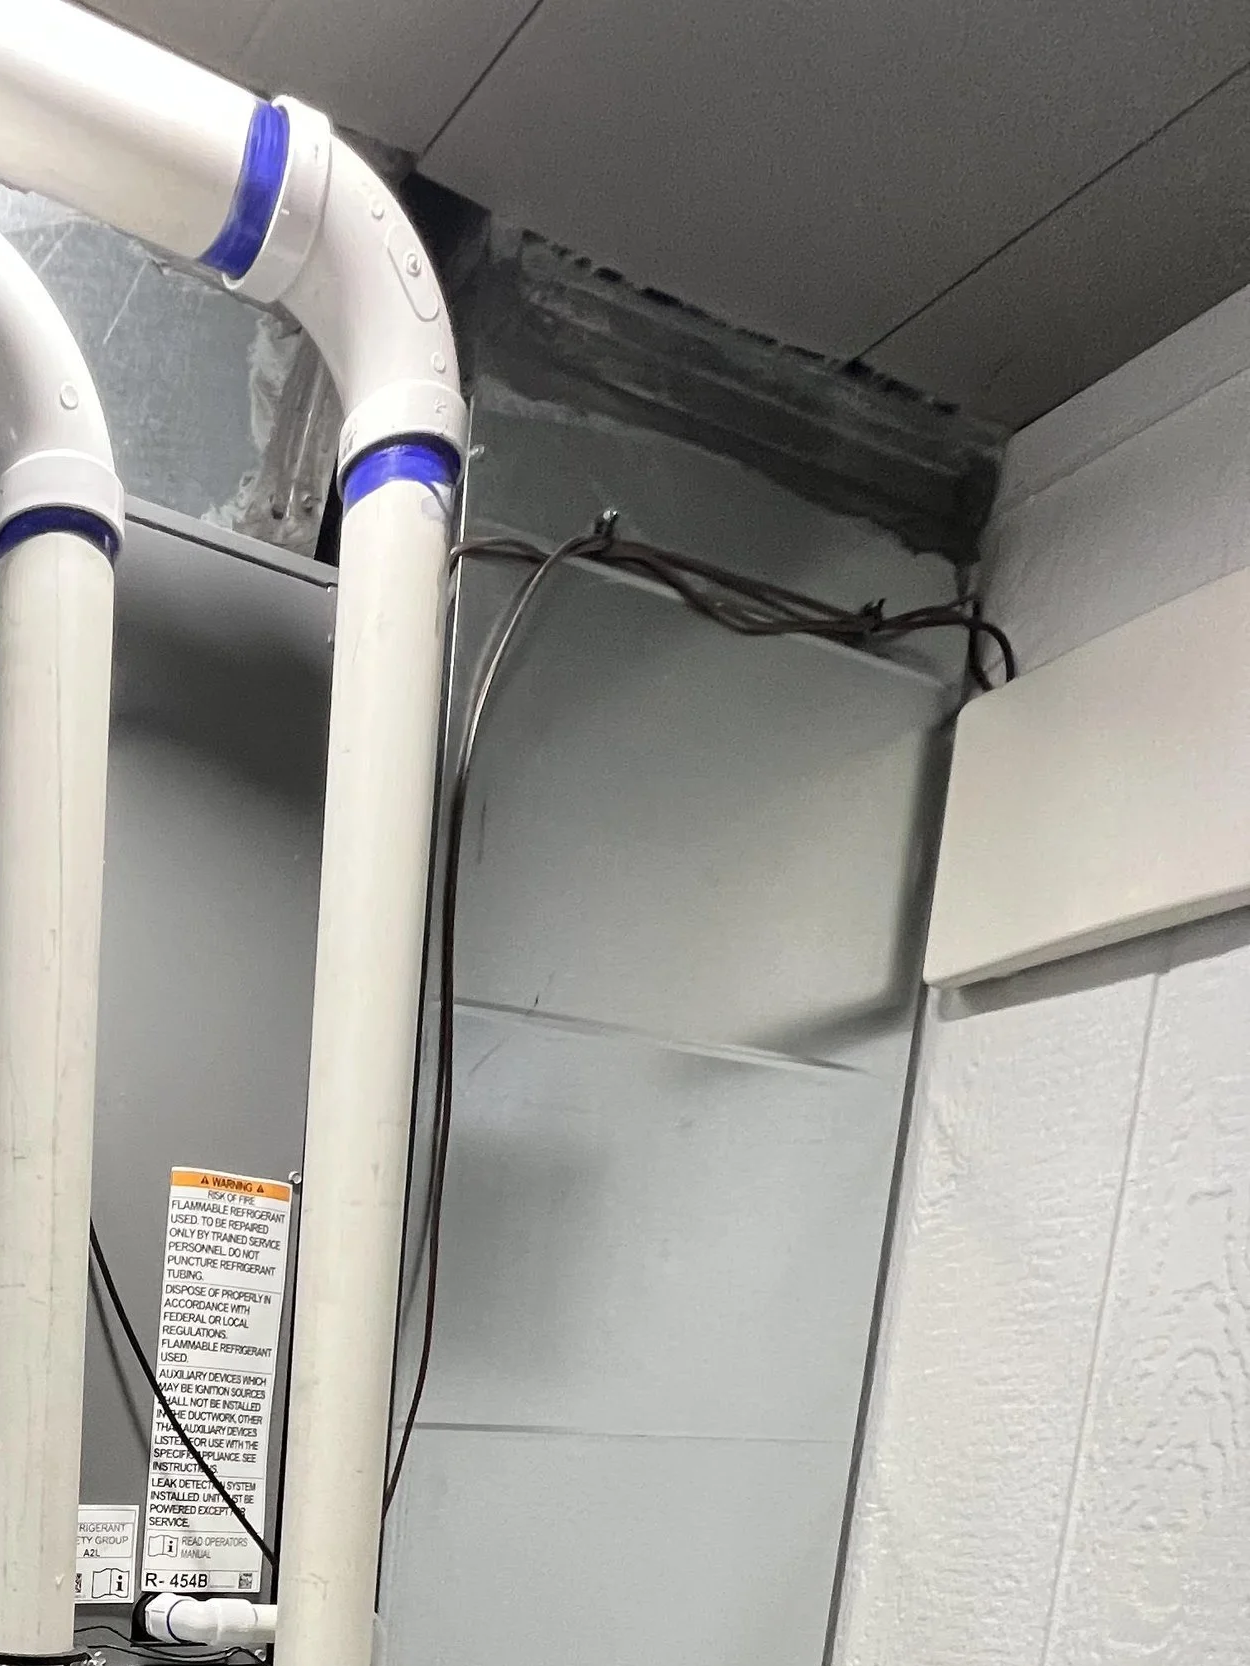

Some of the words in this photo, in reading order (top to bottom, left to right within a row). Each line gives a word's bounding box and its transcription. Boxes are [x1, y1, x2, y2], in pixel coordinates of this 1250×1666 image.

[212, 1177, 253, 1193] WARNING
[208, 1190, 225, 1201] RISK
[227, 1192, 237, 1202] OF
[239, 1194, 255, 1206] FIRE
[171, 1200, 229, 1216] FLAMMABLE
[230, 1207, 286, 1224] REFRIGERANT
[170, 1214, 199, 1225] USED.
[202, 1216, 214, 1227] TO
[215, 1218, 227, 1229] BE
[228, 1219, 270, 1235] REPAIRED
[169, 1227, 196, 1239] ONLY
[197, 1229, 210, 1240] BY
[211, 1231, 248, 1245] TRAINED
[248, 1237, 281, 1251] SERVICE
[228, 1247, 241, 1258] DO
[242, 1249, 260, 1261] NOT
[167, 1255, 219, 1269] PUNCTURE
[220, 1260, 277, 1277] REFRIGERANT
[166, 1268, 204, 1281] TUBING.
[165, 1284, 207, 1297] DISPOSE
[208, 1287, 220, 1298] OF
[221, 1289, 263, 1304] PROPERLY
[263, 1294, 272, 1305] IN
[163, 1298, 229, 1312] ACCORDANCE
[230, 1303, 251, 1315] WITH
[163, 1311, 206, 1324] FEDERAL
[208, 1315, 222, 1325] OR
[222, 1317, 250, 1329] LOCAL
[162, 1325, 228, 1339] REGULATIONS.
[161, 1338, 219, 1352] FLAMMABLE
[220, 1343, 273, 1358] REFRIGERANT
[160, 1352, 189, 1363] USED.
[158, 1368, 208, 1381] AUXILIARY
[209, 1372, 242, 1385] DEVICES
[242, 1375, 267, 1386] WHICH
[158, 1382, 180, 1392] MAY
[180, 1383, 193, 1394] BE
[194, 1384, 230, 1396] IGNITION
[231, 1388, 266, 1400] SOURCES
[158, 1395, 189, 1407] HALL
[190, 1397, 209, 1408] NOT
[210, 1398, 222, 1409] BE
[222, 1399, 261, 1412] INSTALLED
[156, 1408, 166, 1419] IN
[237, 1414, 263, 1425] OTHER
[156, 1421, 181, 1432] THA
[182, 1423, 227, 1435] AUXILIARY
[226, 1426, 258, 1438] DEVICES
[188, 1437, 207, 1448] FOR
[208, 1438, 224, 1449] USE
[225, 1439, 244, 1450] WITH
[245, 1440, 259, 1451] THE
[242, 1453, 257, 1463] SEE
[152, 1461, 218, 1474] INSTRUCTIS.
[151, 1477, 178, 1488] LEAK
[226, 1481, 256, 1491] SYSTEM
[150, 1491, 200, 1502] INSTALLED
[202, 1492, 221, 1503] UNIT
[243, 1495, 255, 1504] BE
[149, 1504, 196, 1515] POWERED
[197, 1505, 229, 1516] EXCEPT
[79, 1523, 125, 1533] RIGERANT
[94, 1535, 129, 1545] GROUP
[181, 1536, 203, 1547] READ
[205, 1536, 248, 1547] OPERATORS
[83, 1548, 100, 1557] A2L
[180, 1549, 212, 1559] MANUAL
[169, 1573, 208, 1588] 454B
